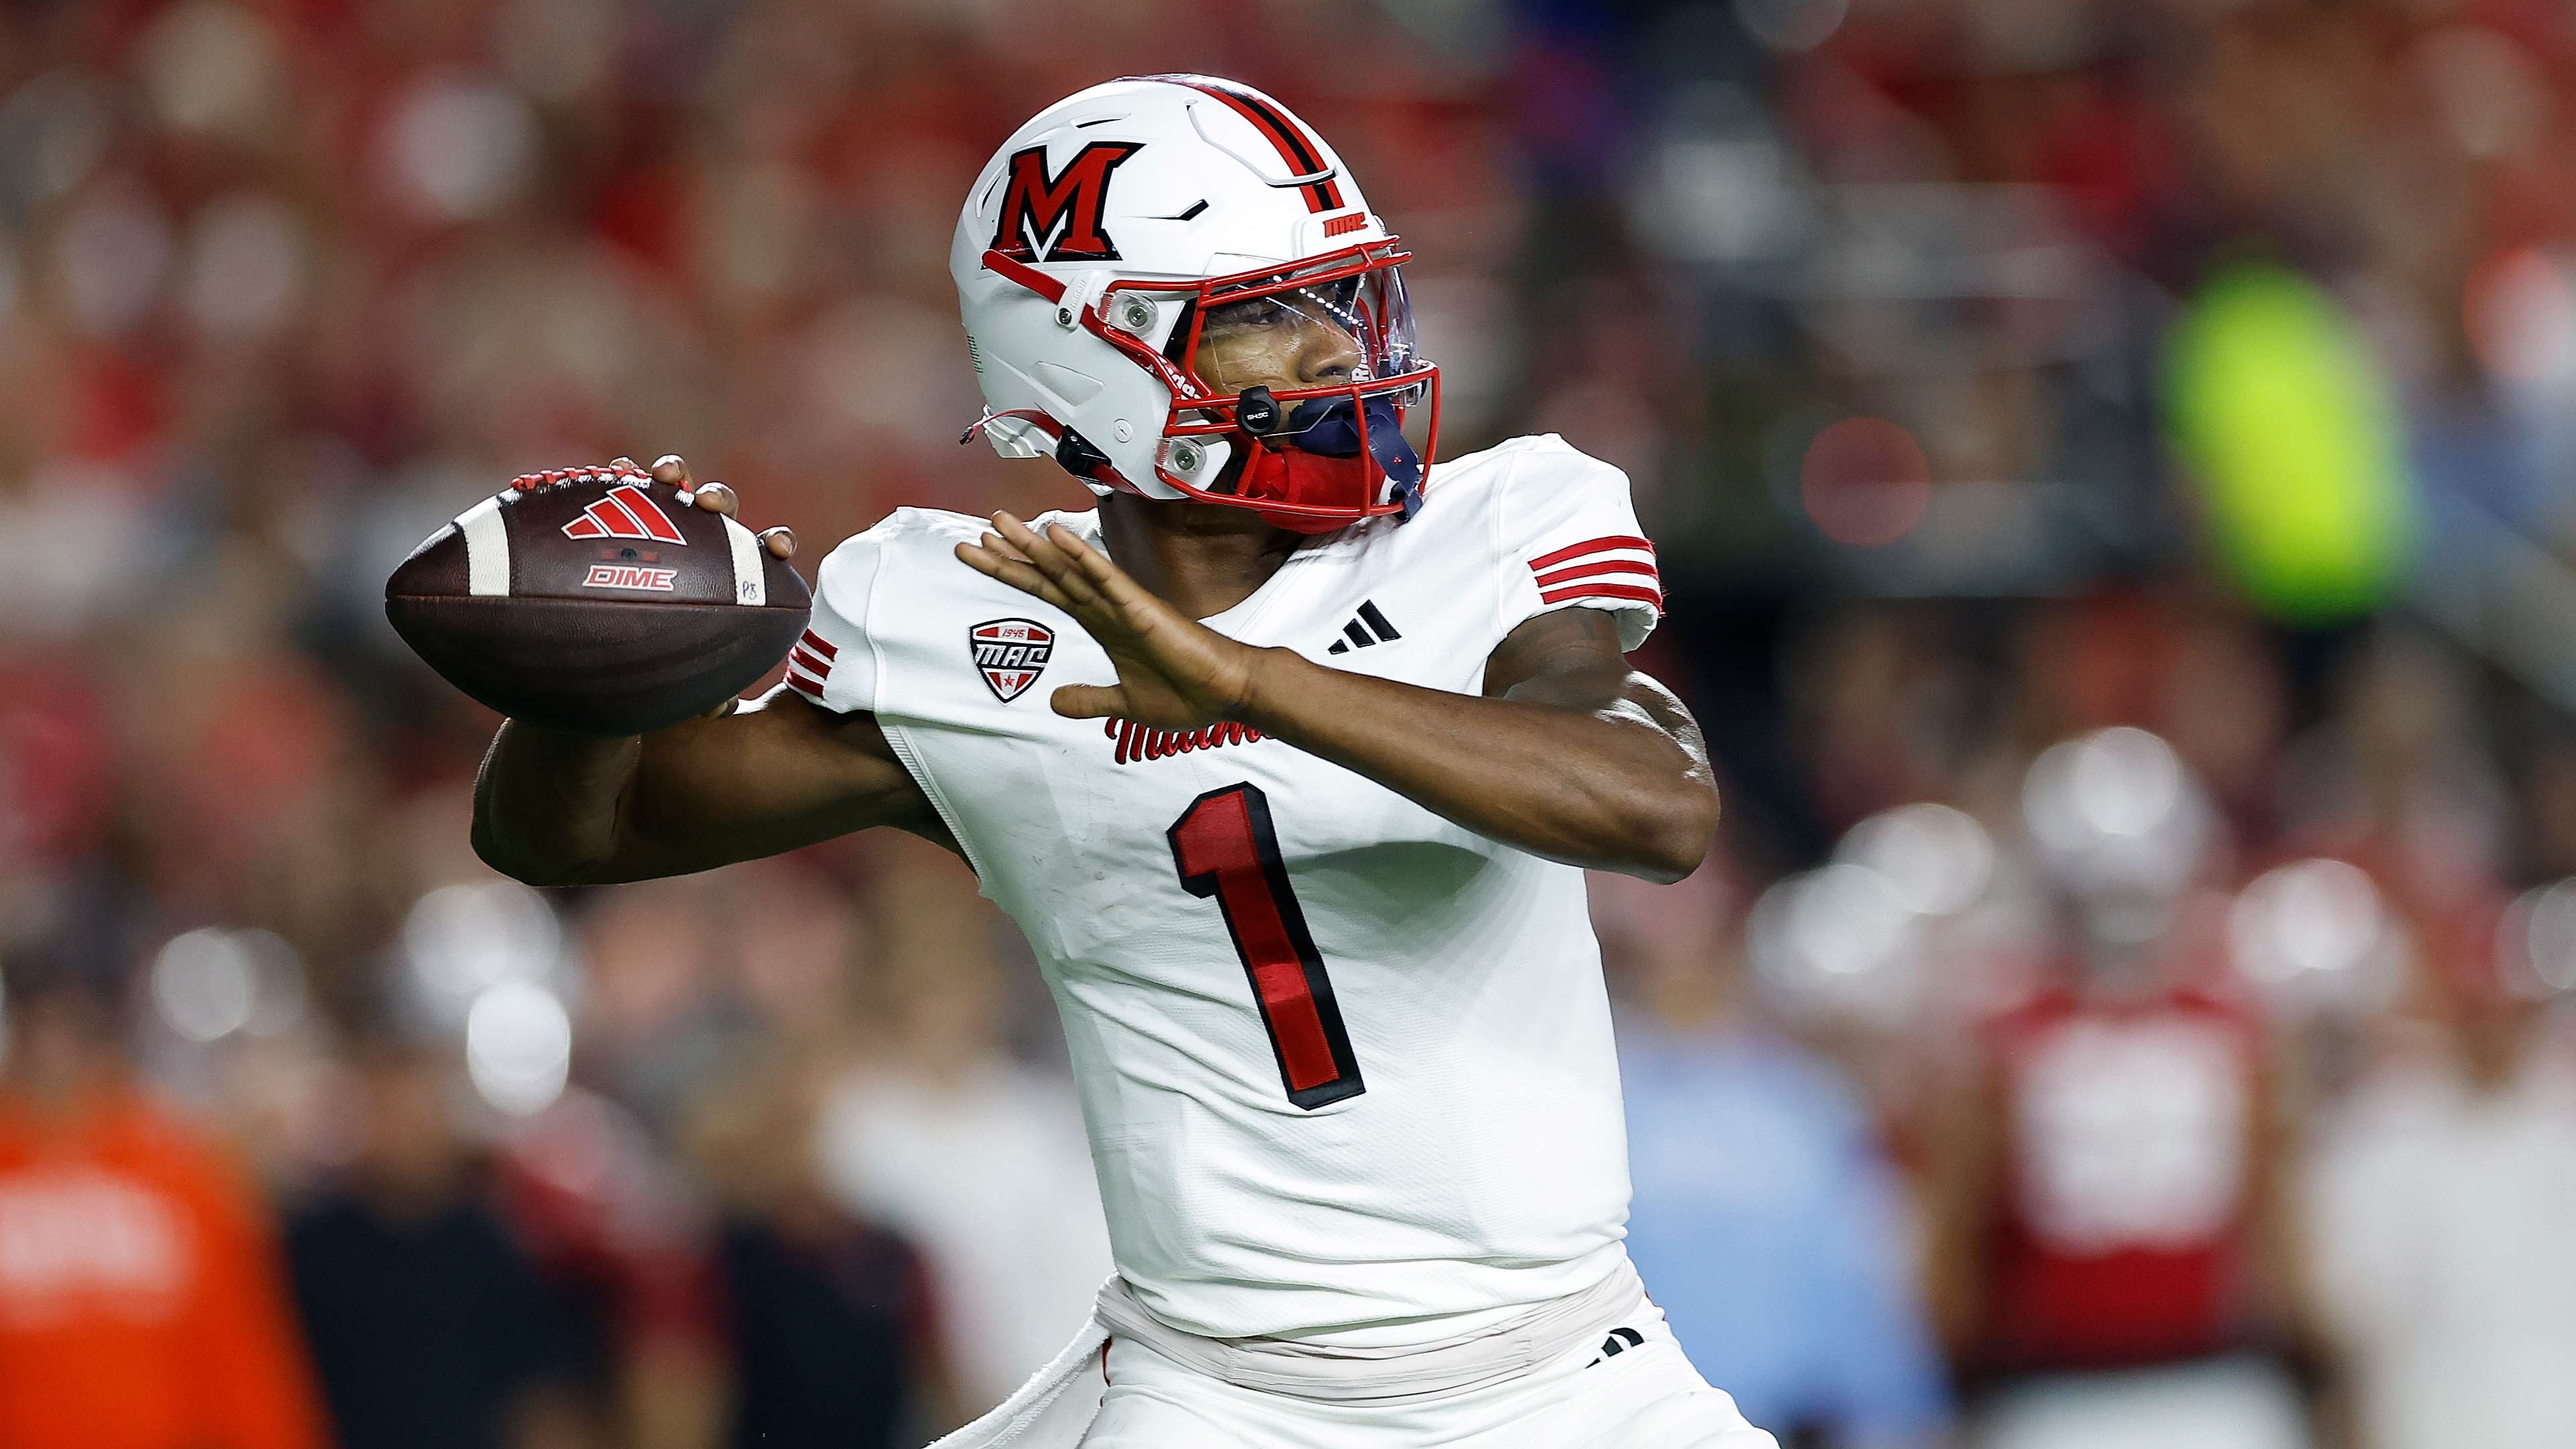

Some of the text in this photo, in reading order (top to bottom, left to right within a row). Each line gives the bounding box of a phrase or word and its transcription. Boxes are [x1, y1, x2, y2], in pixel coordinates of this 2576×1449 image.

[981, 141, 1147, 270] M
[1322, 211, 1368, 238] MAC
[583, 565, 678, 591] DIME
[1002, 628, 1026, 639] 1946
[975, 643, 1048, 667] MAC
[1104, 716, 1275, 765] Miam
[1166, 781, 1366, 1111] 1
